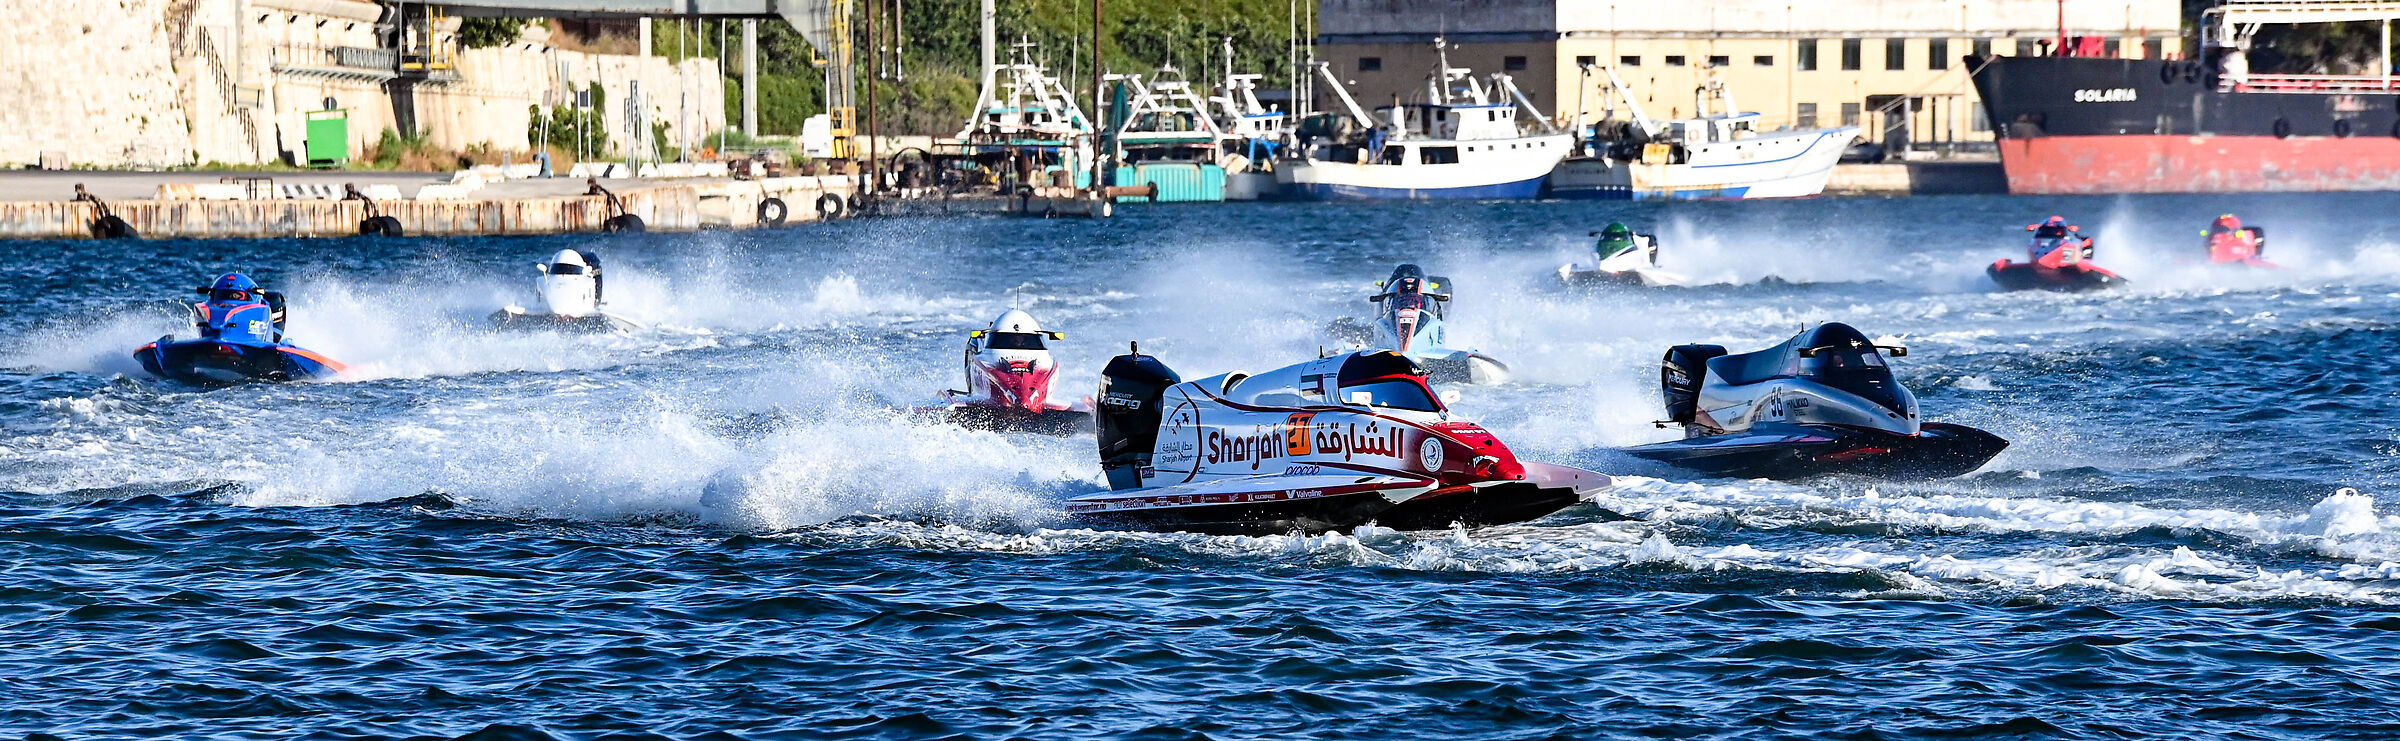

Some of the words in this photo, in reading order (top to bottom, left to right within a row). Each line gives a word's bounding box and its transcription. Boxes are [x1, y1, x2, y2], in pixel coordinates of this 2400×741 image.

[2074, 88, 2137, 102] SOLARIA
[1770, 386, 1784, 417] 96
[1207, 423, 1284, 471] Sharjah
[1287, 416, 1311, 449] 27
[1315, 420, 1405, 462] الشارقة
[1162, 454, 1178, 464] Sharjah
[1296, 489, 1323, 498] Valvoline
